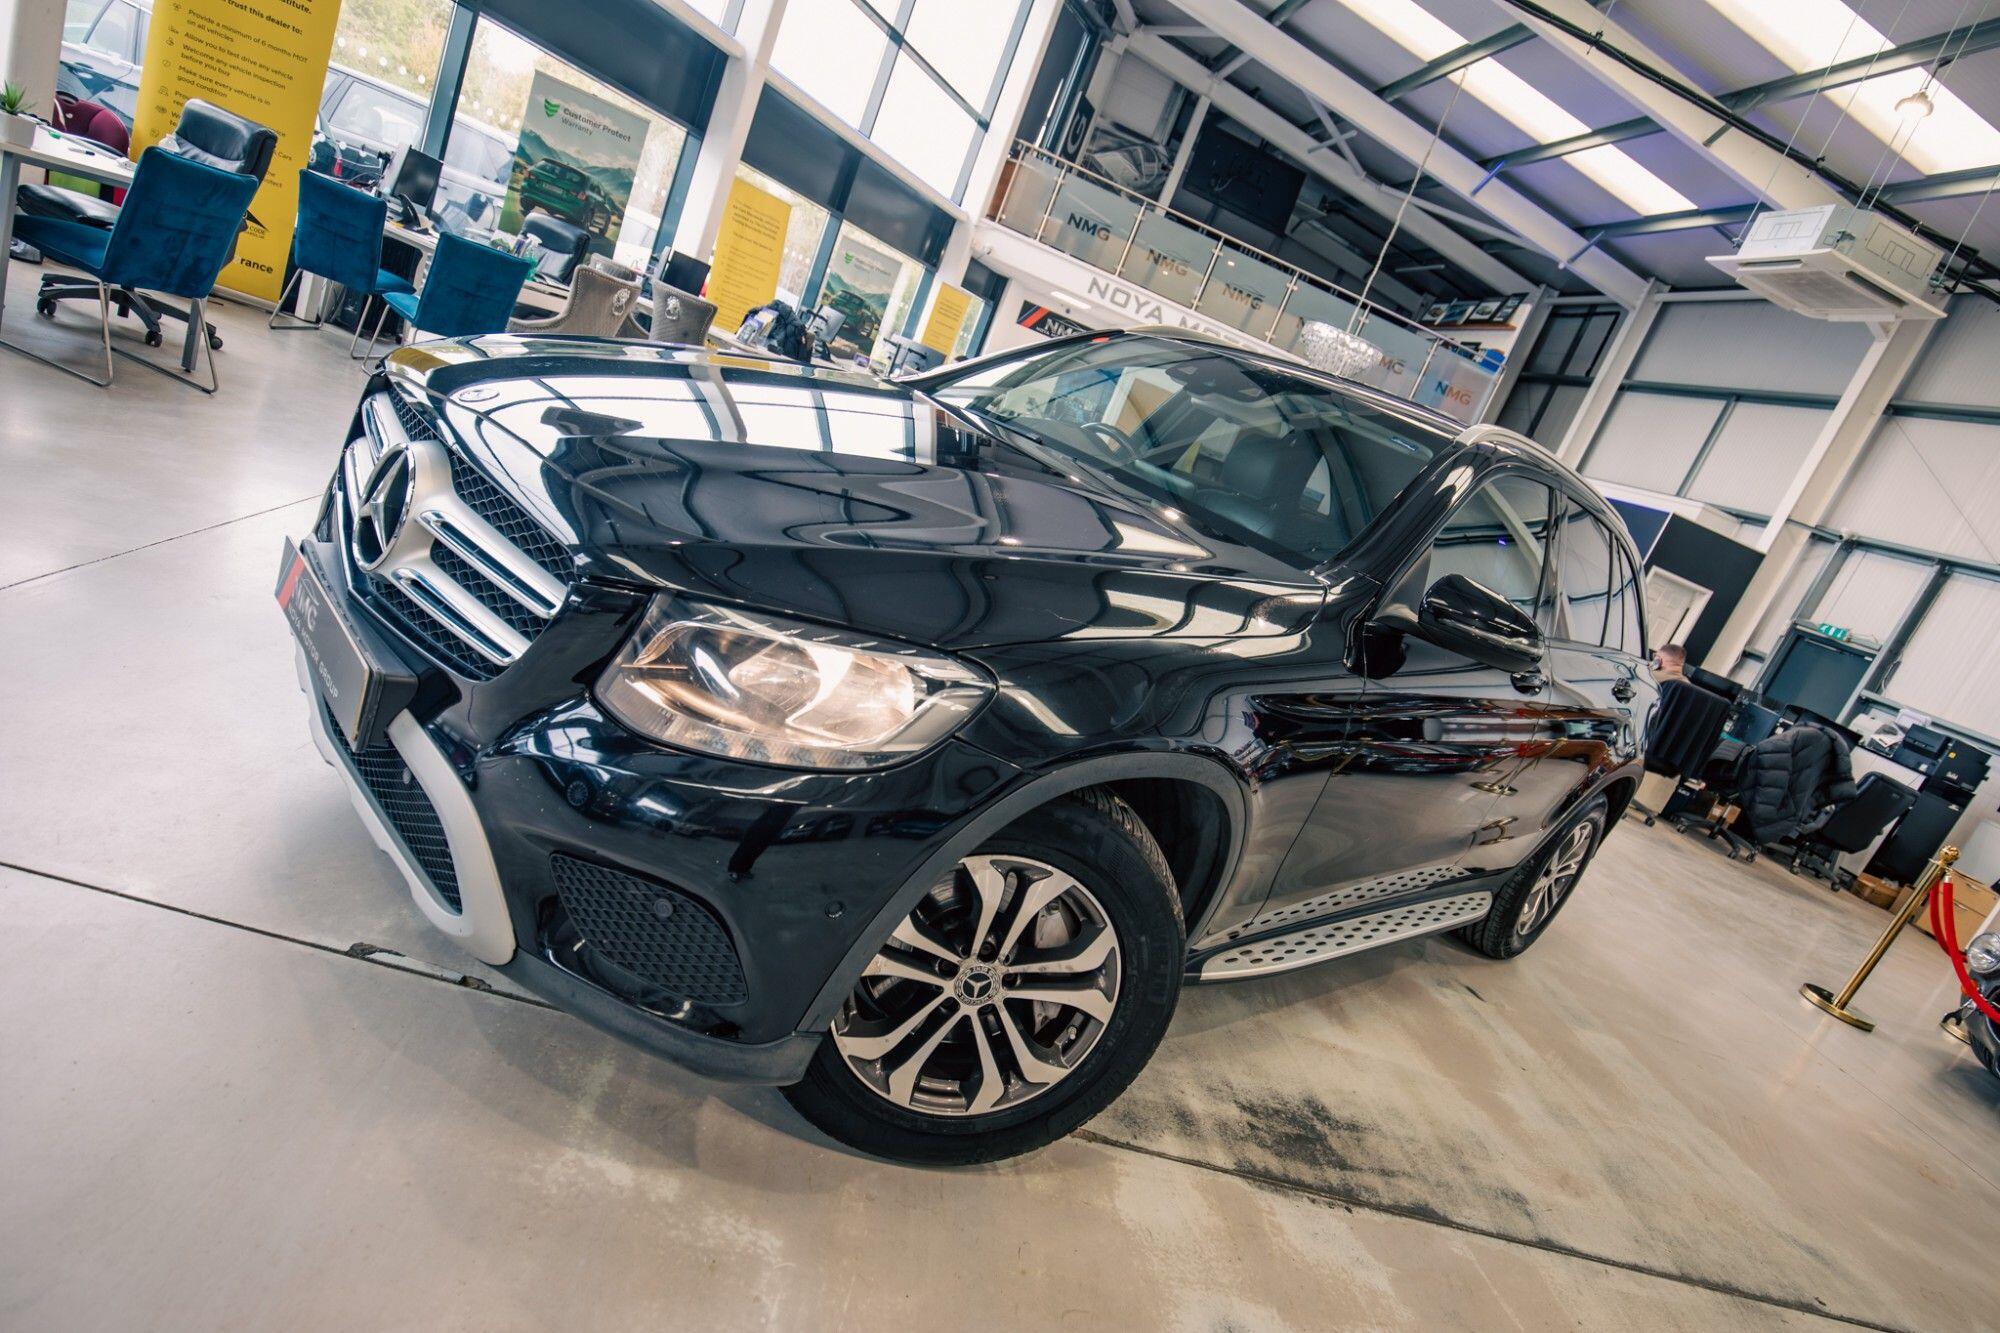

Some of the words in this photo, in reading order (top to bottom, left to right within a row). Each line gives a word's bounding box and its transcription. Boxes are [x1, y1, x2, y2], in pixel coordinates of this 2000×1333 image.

[249, 7, 264, 18] this
[265, 15, 290, 29] dealer
[291, 25, 303, 35] to:
[281, 0, 312, 14] titute.
[188, 9, 215, 25] Provide
[221, 24, 253, 40] minimum
[266, 43, 292, 57] months
[292, 52, 308, 63] MOT
[197, 22, 206, 31] all
[207, 28, 234, 43] vehicles
[181, 52, 204, 65] before
[204, 62, 217, 73] you
[218, 67, 230, 77] buy
[183, 44, 215, 61] Welcome
[215, 58, 228, 67] any
[229, 63, 252, 76] vehicle
[253, 71, 286, 91] inspection
[184, 32, 204, 44] Allow
[205, 42, 218, 51] you
[227, 49, 240, 59] test
[241, 55, 258, 66] drive
[258, 61, 270, 72] any
[271, 67, 294, 80] vehicle
[177, 75, 195, 87] good
[195, 82, 228, 98] condition
[178, 65, 198, 77] Make
[198, 74, 214, 84] sure
[214, 80, 232, 92] every
[234, 88, 256, 101] vehicle
[561, 117, 593, 136] Warranty
[563, 107, 601, 129] Customer
[602, 125, 631, 142] Protect
[1067, 212, 1111, 241] NMG
[240, 257, 274, 274] rance
[1147, 248, 1188, 276] NMG
[1087, 276, 1163, 325] NOYA
[1222, 283, 1264, 310] NMG
[1379, 355, 1404, 375] MG
[1435, 381, 1472, 405] NMG
[300, 628, 319, 664] MOTOR
[318, 661, 339, 699] GROUP
